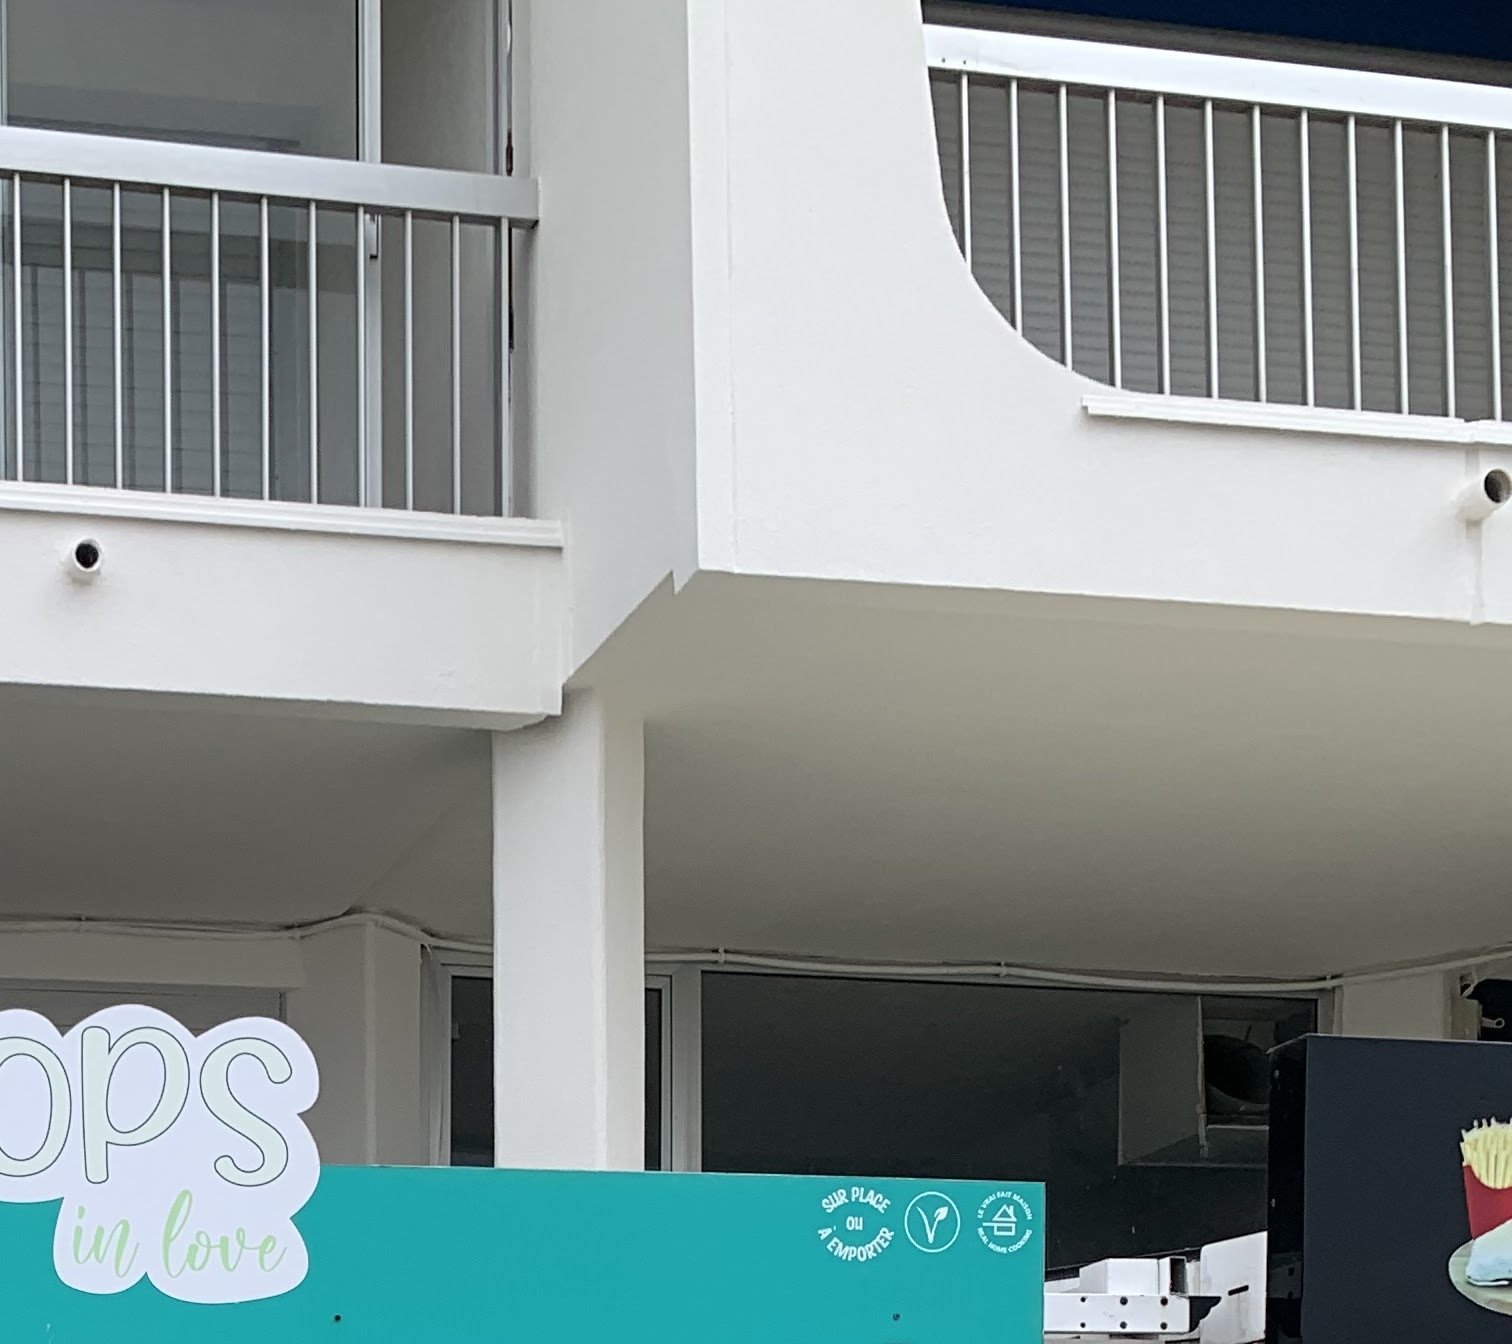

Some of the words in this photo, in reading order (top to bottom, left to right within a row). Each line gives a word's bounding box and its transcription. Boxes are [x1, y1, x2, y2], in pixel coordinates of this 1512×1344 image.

[821, 1189, 850, 1213] SUR
[851, 1186, 892, 1214] PLACE
[72, 1203, 138, 1278] in
[161, 1189, 287, 1277] love
[817, 1225, 837, 1240] À
[826, 1226, 895, 1262] EMPORTER
